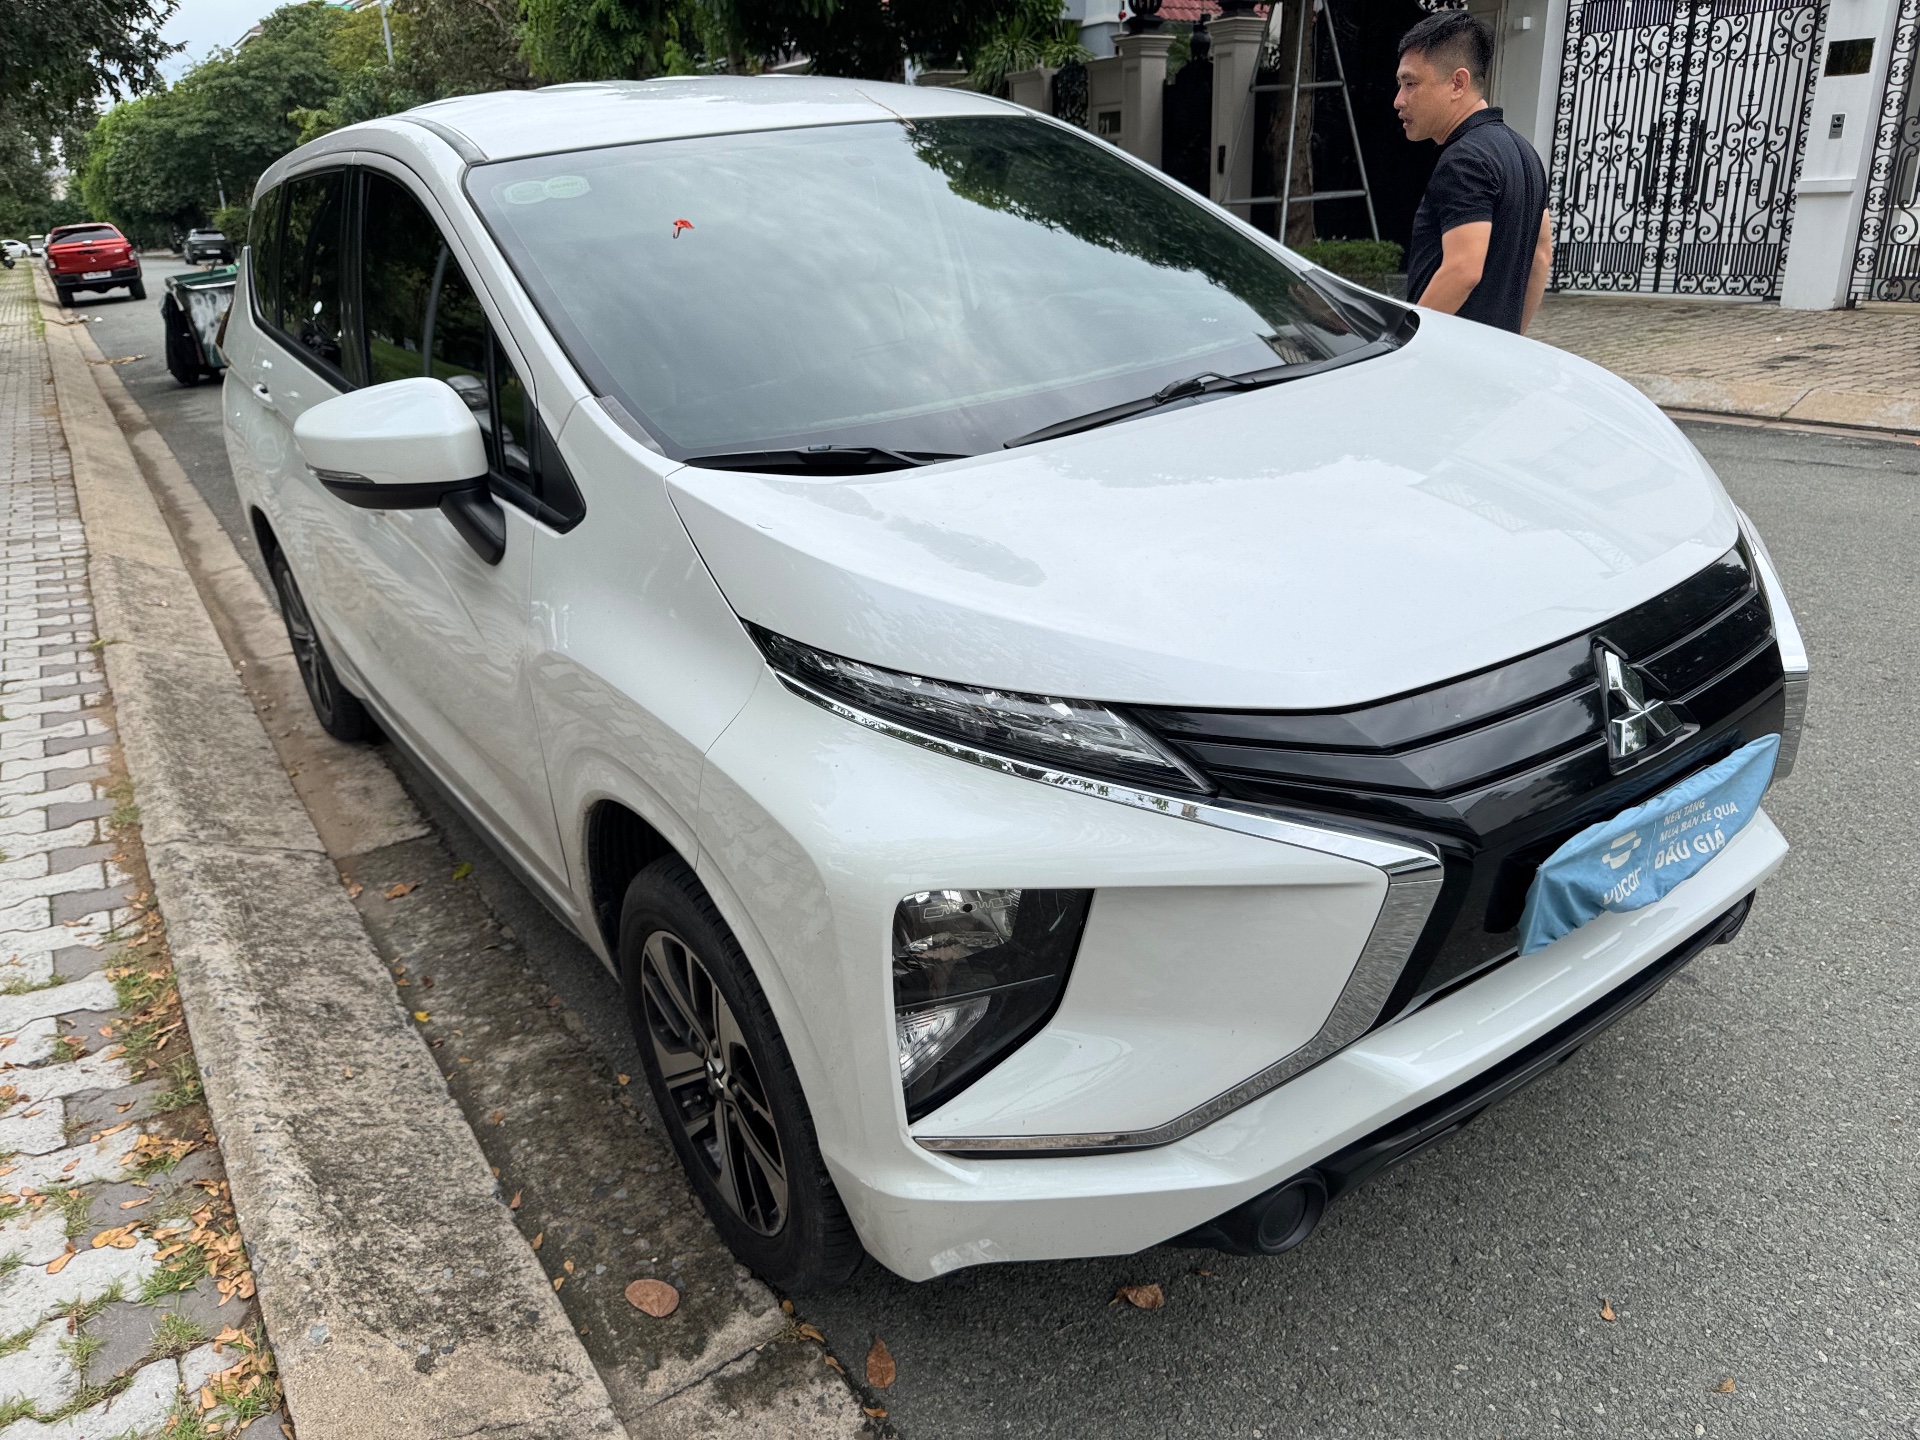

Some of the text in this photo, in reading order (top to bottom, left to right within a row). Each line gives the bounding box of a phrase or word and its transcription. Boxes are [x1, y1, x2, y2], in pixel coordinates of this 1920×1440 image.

[1699, 809, 1713, 824] XE
[1713, 801, 1739, 820] QUA
[1693, 822, 1726, 854] GIÁ
